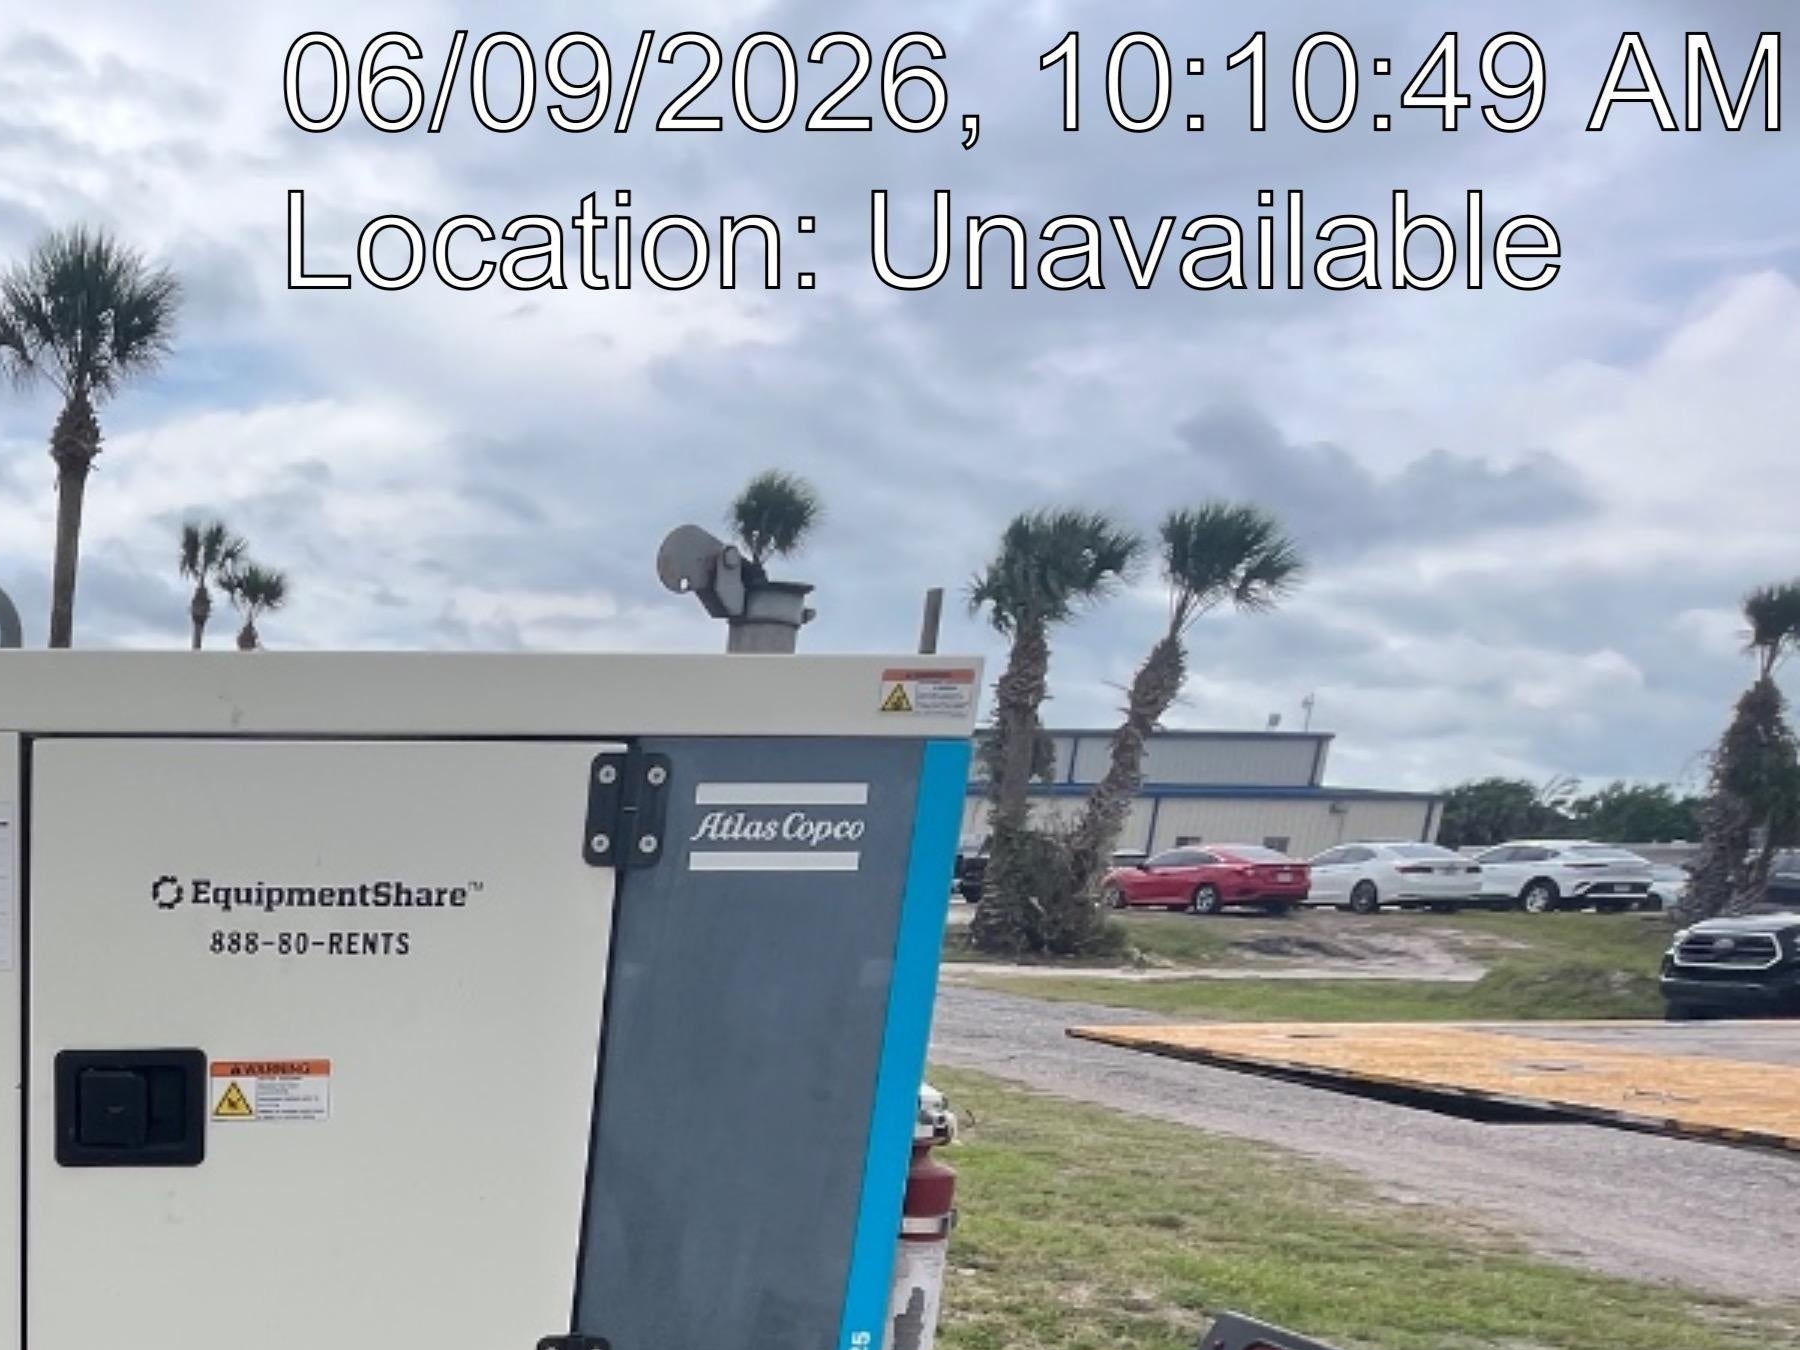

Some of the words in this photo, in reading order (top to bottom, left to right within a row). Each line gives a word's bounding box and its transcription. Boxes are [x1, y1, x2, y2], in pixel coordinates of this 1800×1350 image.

[689, 811, 779, 841] Atlas
[782, 812, 866, 847] Copco
[191, 879, 466, 912] EquipmentShare
[210, 929, 410, 955] 888-80-RENTS
